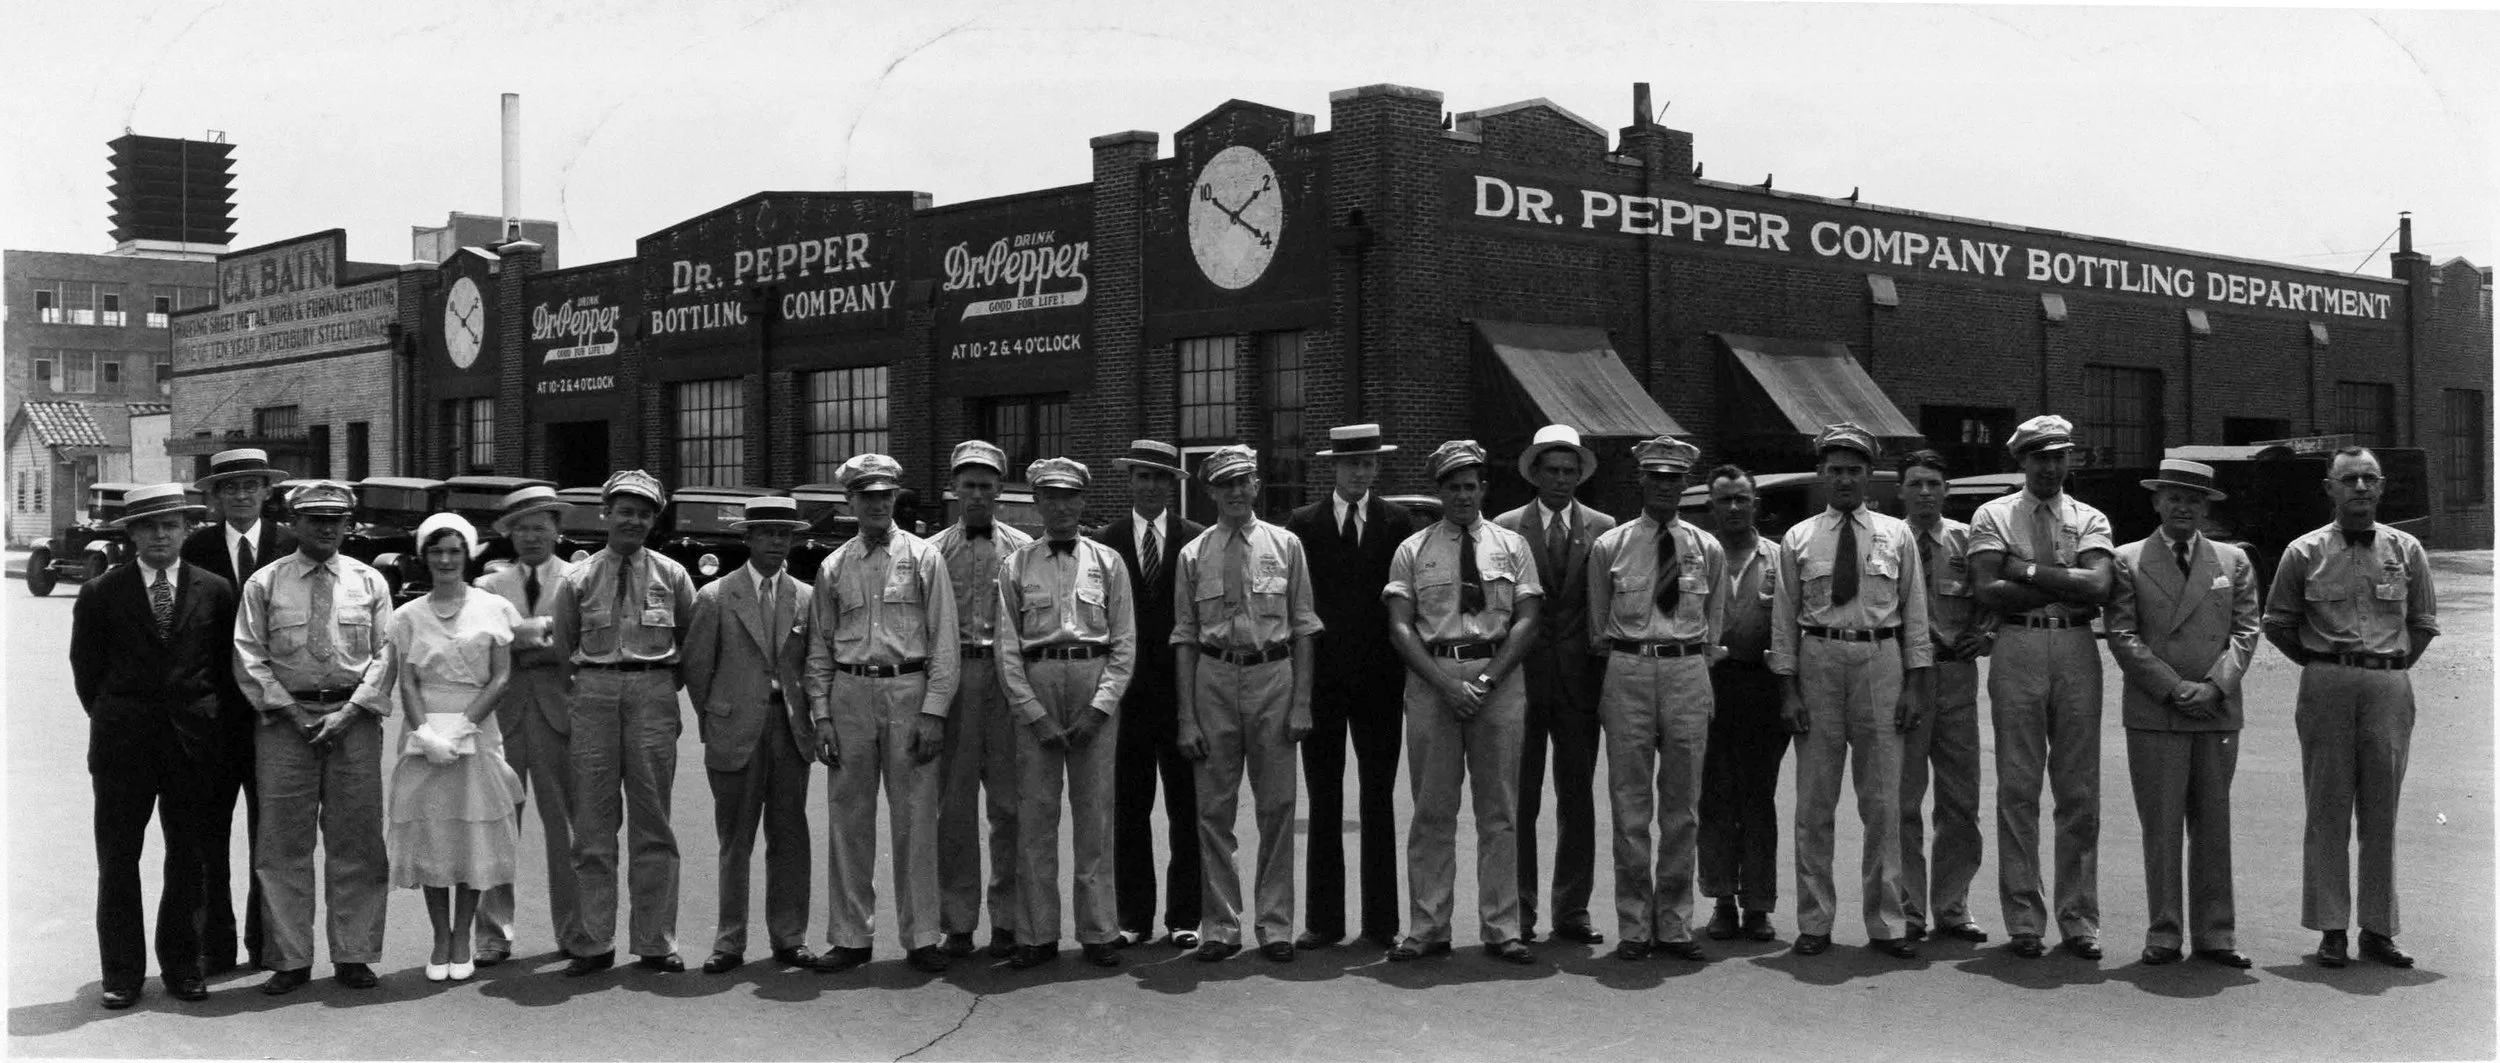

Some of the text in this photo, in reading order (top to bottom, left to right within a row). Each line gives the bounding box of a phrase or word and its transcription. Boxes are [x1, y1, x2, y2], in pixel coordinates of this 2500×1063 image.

[1200, 183, 1212, 202] 10
[1262, 174, 1271, 191] 2
[1014, 230, 1056, 248] DRINK
[1260, 231, 1272, 250] 4
[1474, 175, 2391, 319] DR. PEPPER COMPANY BOTTLING DEPARTMENT
[672, 233, 871, 294] DR. PEPPER
[307, 291, 352, 320] FURNACE
[355, 284, 395, 311] HEATING
[782, 280, 896, 319] COMPANY
[988, 301, 1012, 313] GOOD
[1017, 298, 1034, 309] FOR
[318, 322, 349, 343] STEEL
[952, 344, 967, 360] AT
[1001, 340, 1011, 355] &
[1014, 339, 1023, 354] 4
[1025, 334, 1081, 354] O'CLOCK
[537, 381, 546, 394] AT
[574, 378, 580, 391] 4
